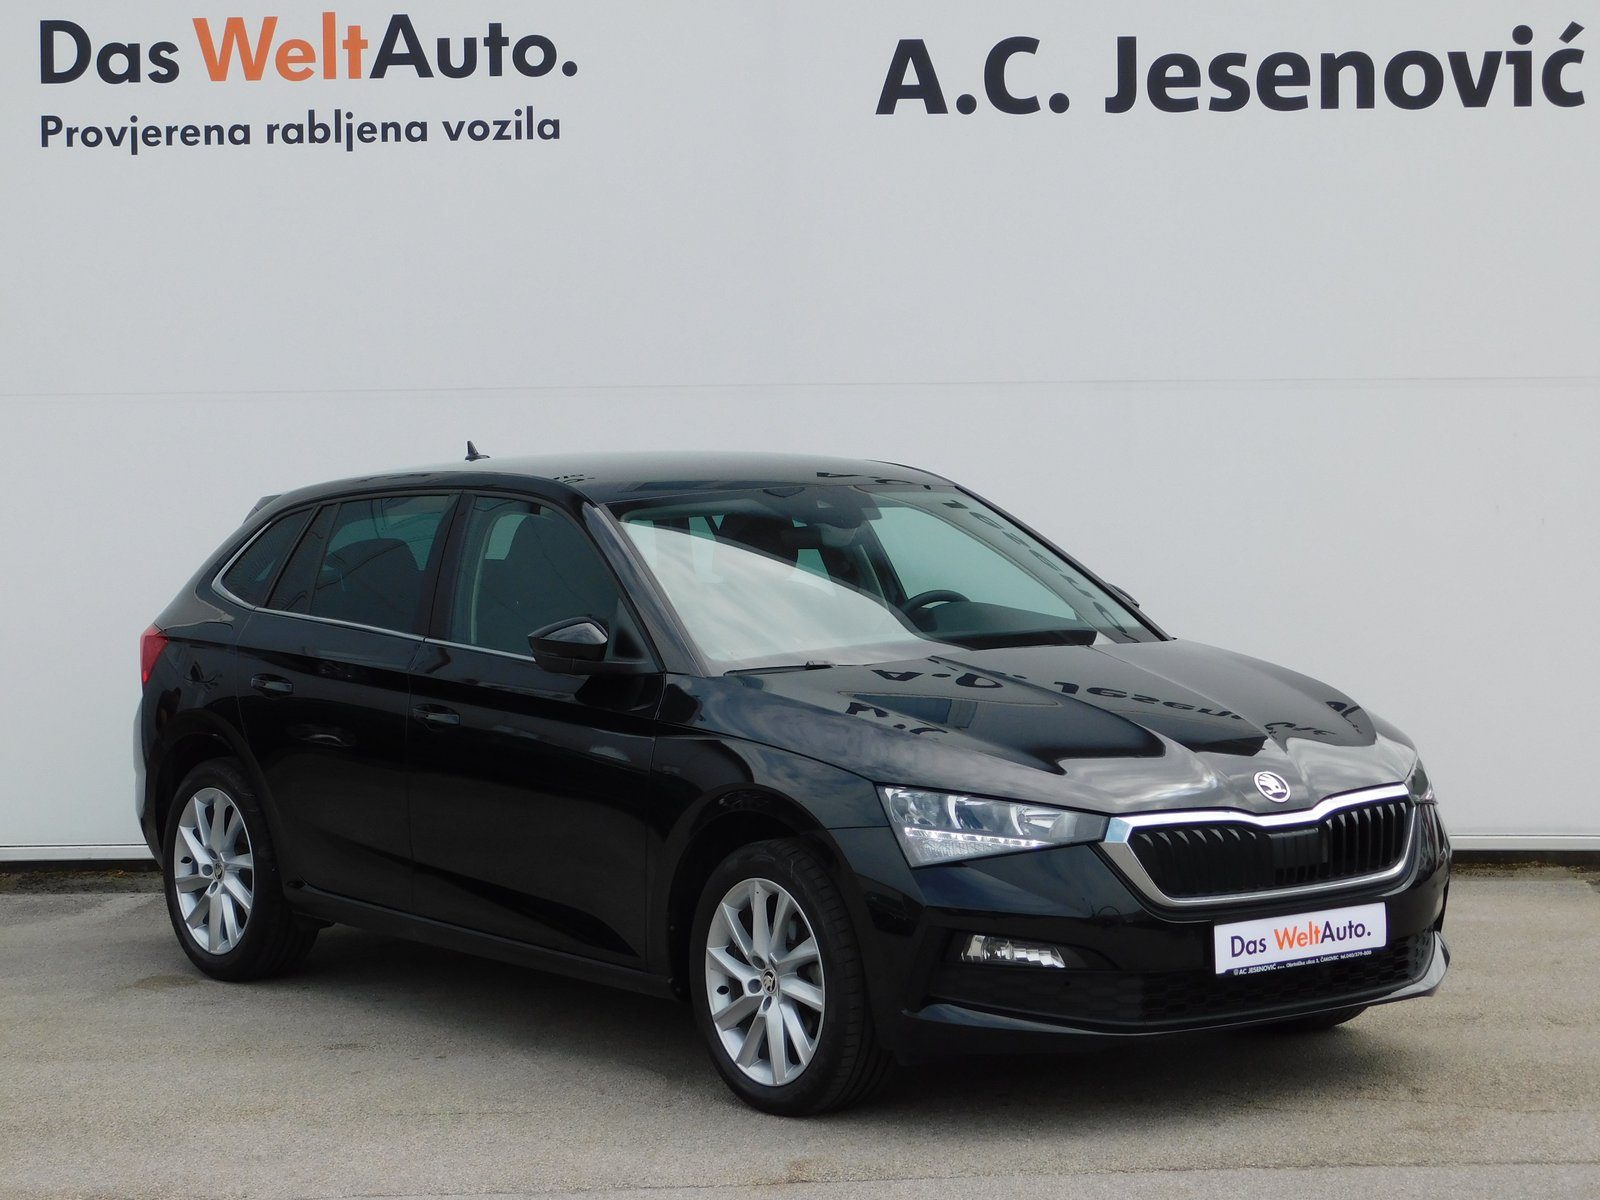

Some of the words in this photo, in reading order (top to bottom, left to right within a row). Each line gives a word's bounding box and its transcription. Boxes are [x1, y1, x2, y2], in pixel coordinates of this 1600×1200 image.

[40, 19, 179, 84] Das
[192, 12, 577, 81] WeltAuto.
[876, 36, 1069, 115] A.C.
[1105, 21, 1585, 113] Jesenović
[40, 114, 250, 155] Provjerena
[266, 109, 427, 152] rabljena
[441, 106, 559, 141] vozila
[1230, 935, 1267, 958] Das
[1273, 920, 1372, 951] WeltAuto.
